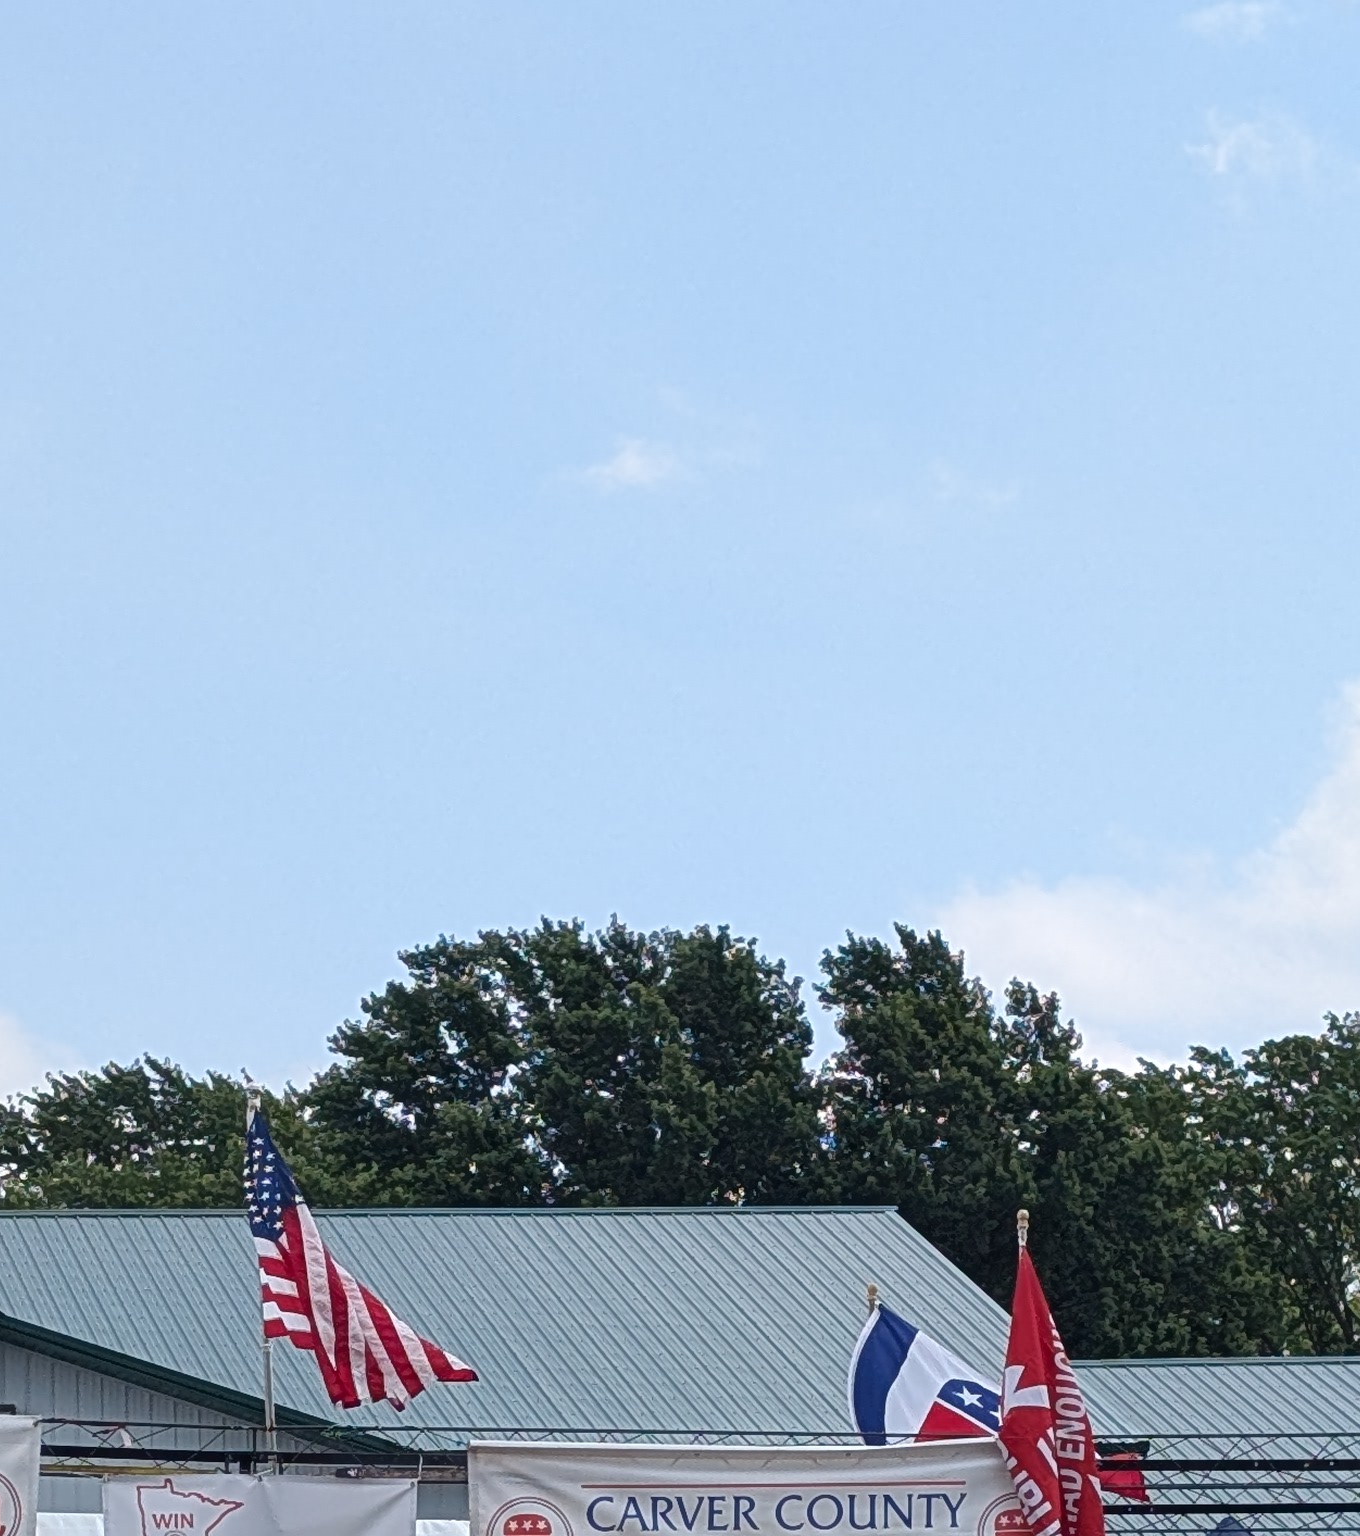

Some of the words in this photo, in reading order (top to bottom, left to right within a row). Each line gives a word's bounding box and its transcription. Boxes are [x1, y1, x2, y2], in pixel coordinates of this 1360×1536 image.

[152, 1513, 194, 1530] WIN
[585, 1495, 760, 1533] CARVER
[774, 1492, 968, 1531] COUNTY
